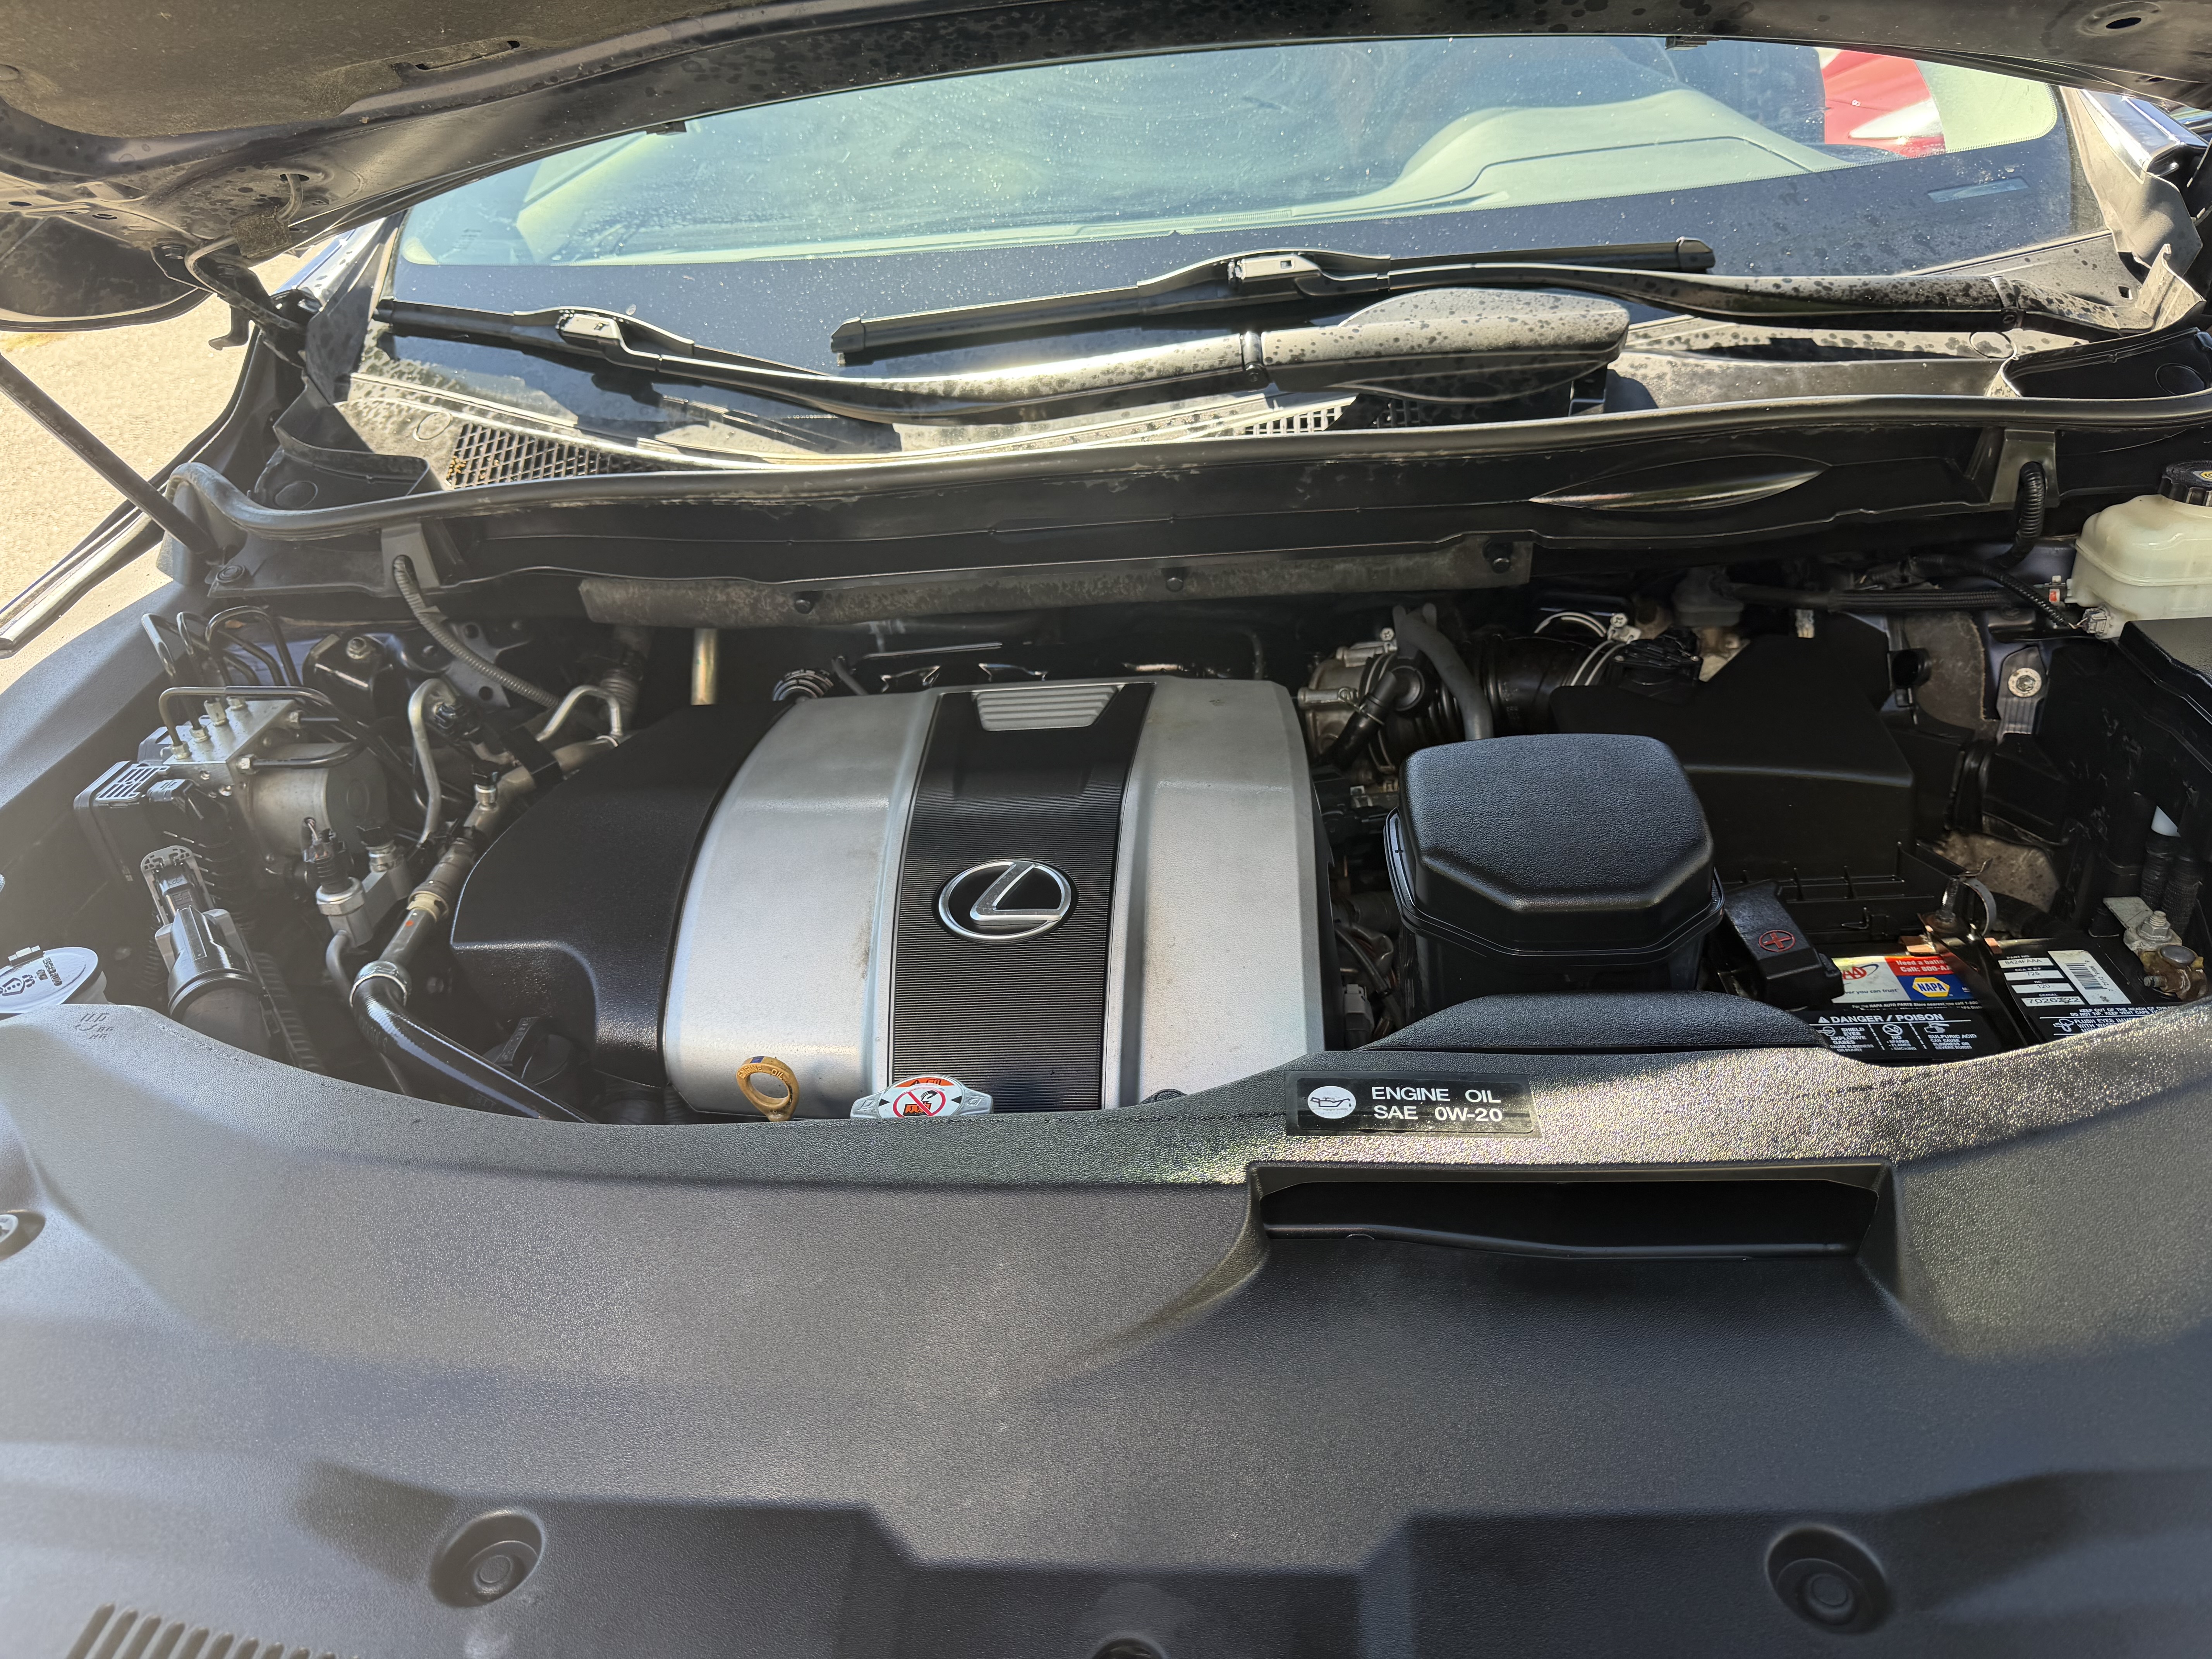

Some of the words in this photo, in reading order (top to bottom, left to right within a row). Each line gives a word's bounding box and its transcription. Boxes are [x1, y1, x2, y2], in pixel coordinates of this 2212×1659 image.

[1917, 983, 1946, 991] NAPA
[737, 1065, 763, 1079] ENGINE
[771, 1069, 783, 1080] OIL
[1372, 1087, 1451, 1101] ENGINE
[1465, 1089, 1501, 1103] OIL
[1374, 1105, 1418, 1120] SAE
[1434, 1106, 1503, 1122] 0W-20
